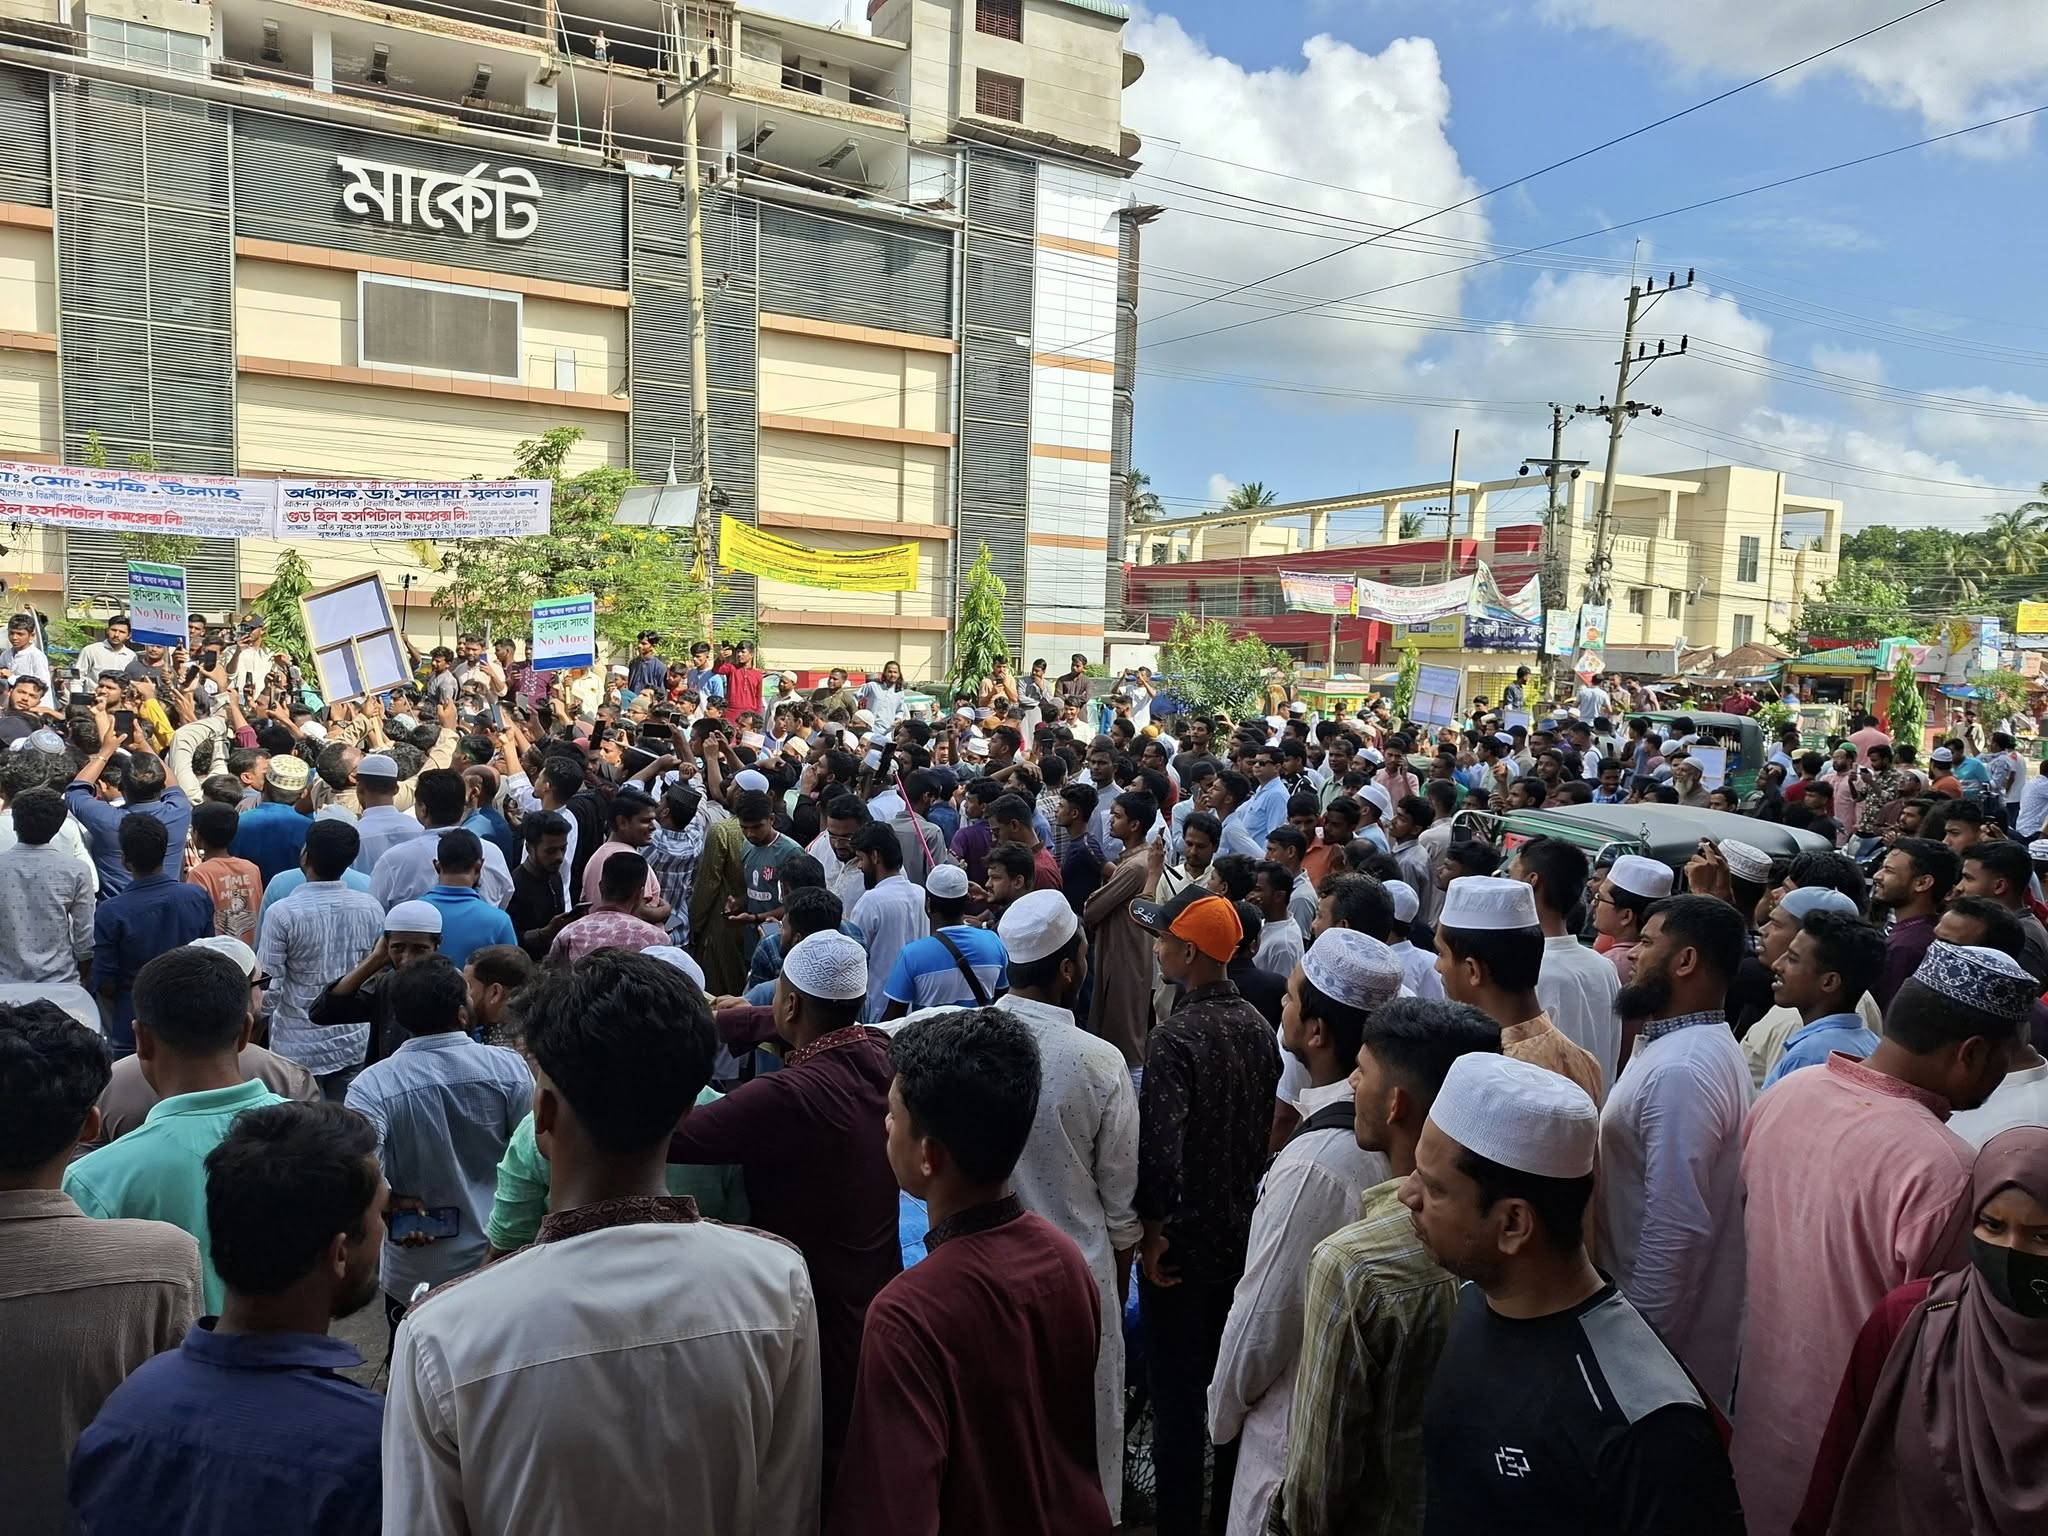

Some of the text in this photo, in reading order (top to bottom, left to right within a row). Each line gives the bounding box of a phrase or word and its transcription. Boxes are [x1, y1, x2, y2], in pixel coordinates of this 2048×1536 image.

[336, 155, 543, 239] মার্কেট
[31, 475, 81, 489] মোঃ
[92, 478, 148, 493] সফি
[158, 480, 244, 501] উল্যাহ
[284, 488, 358, 500] অধ্যাপক
[399, 489, 461, 500] সালমা
[468, 488, 540, 501] সুলতানা
[25, 503, 104, 521] হসপিটাল
[107, 510, 163, 526] কমপ্লেক্স
[287, 511, 311, 523] গুড
[313, 507, 337, 523] হিল
[341, 507, 401, 524] হসপিটাল
[404, 510, 451, 522] কমপ্লেক্স
[134, 606, 182, 622] No More
[536, 617, 590, 633] কুমিল্লার সাথে
[539, 634, 588, 647] No More
